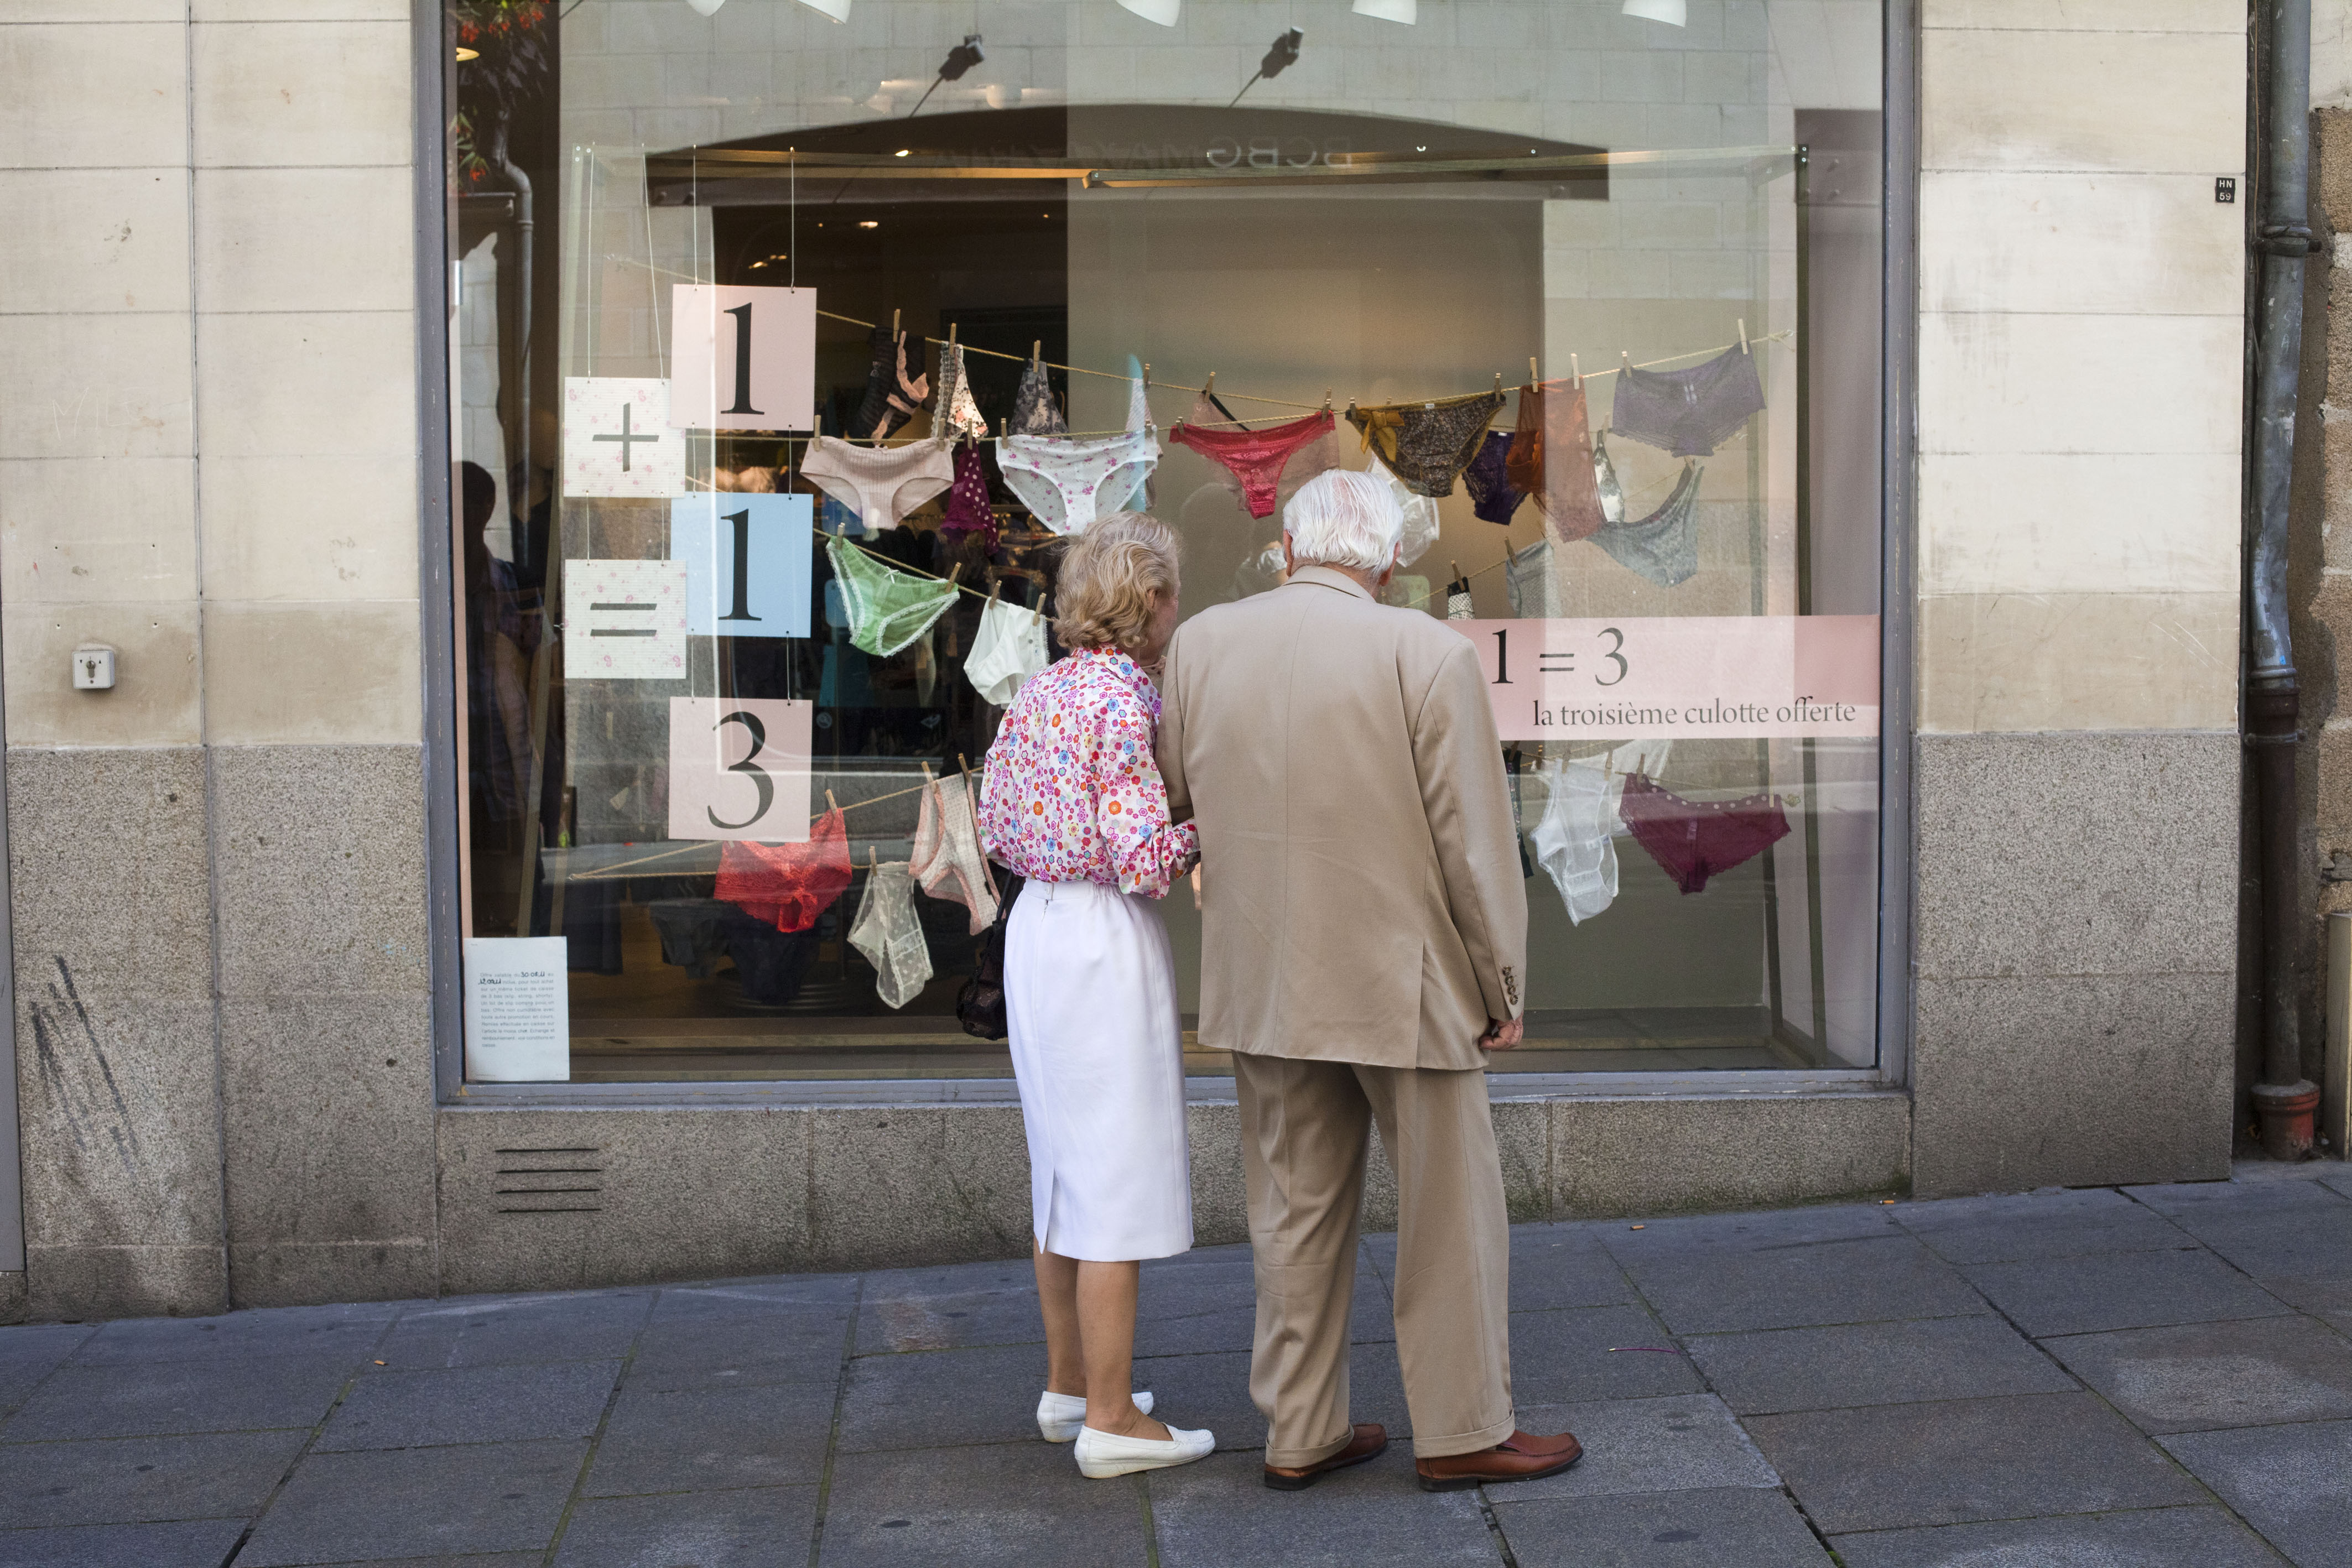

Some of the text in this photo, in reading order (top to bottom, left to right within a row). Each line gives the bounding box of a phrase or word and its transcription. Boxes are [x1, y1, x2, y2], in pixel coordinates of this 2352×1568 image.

[2219, 180, 2232, 188] HN
[2219, 192, 2231, 201] 59
[721, 302, 765, 415] 1
[592, 403, 659, 472] +
[718, 508, 762, 621] 1
[590, 603, 657, 637] =
[1491, 627, 1628, 686] 1 = 3
[1533, 696, 1856, 726] la troisième culotte offerte
[707, 711, 774, 830] 3
